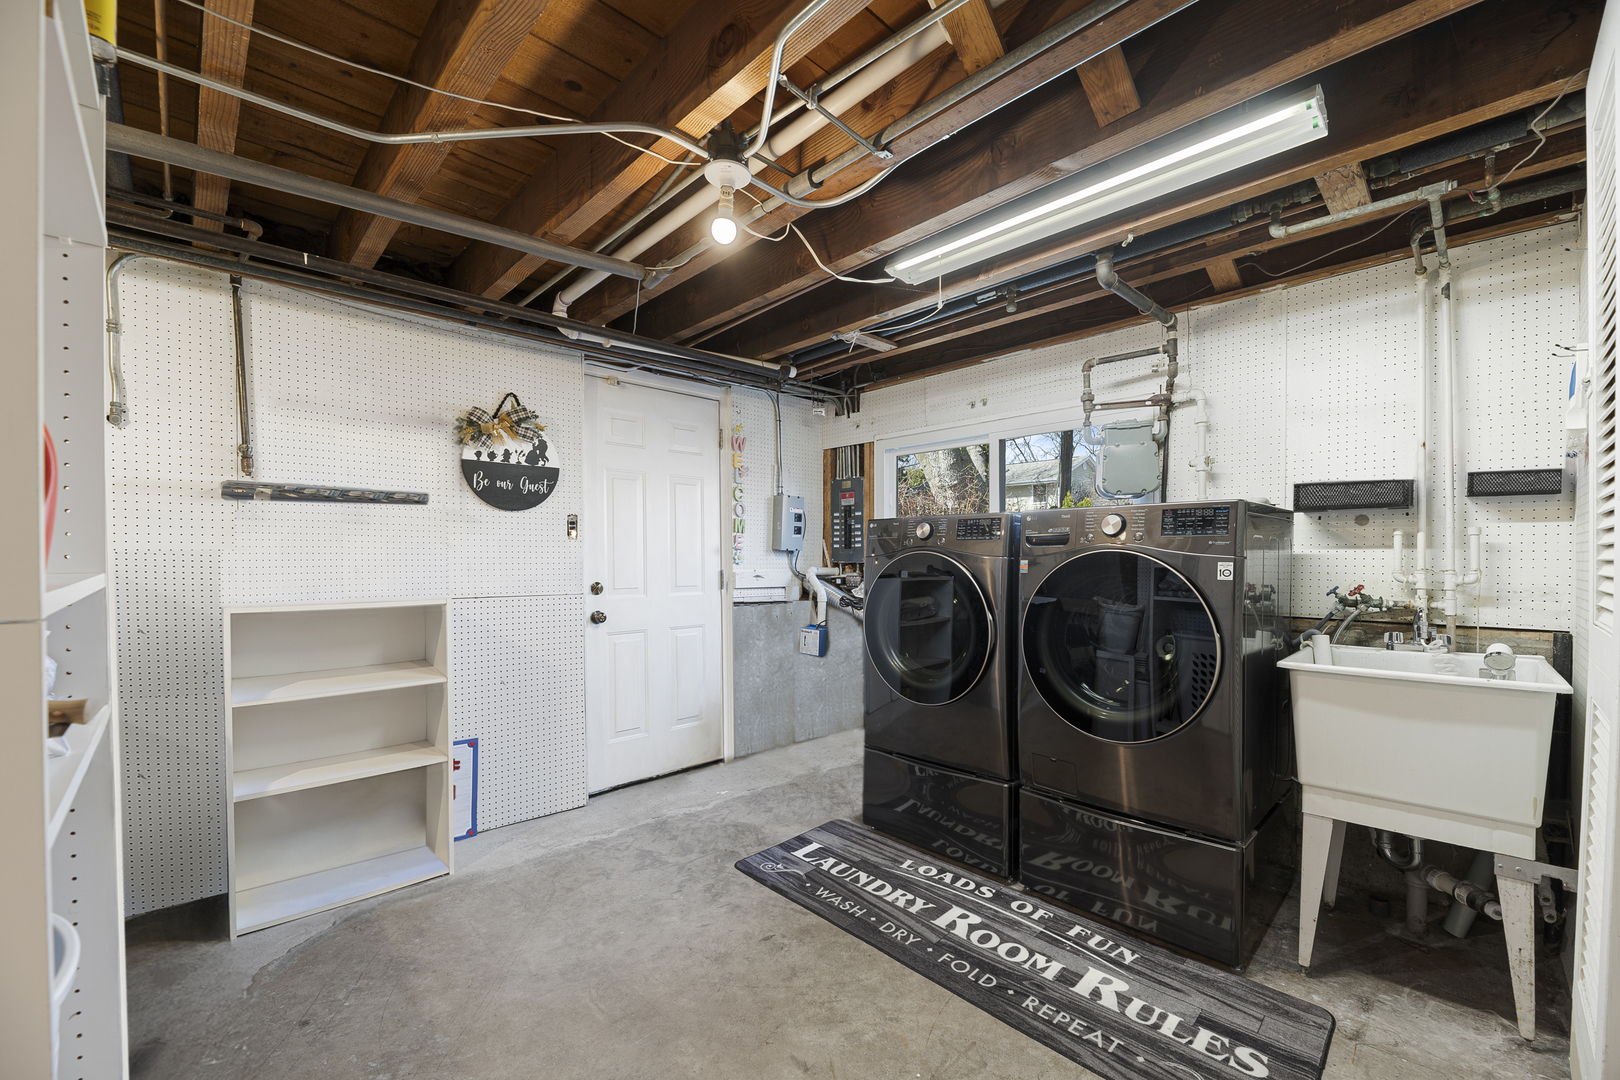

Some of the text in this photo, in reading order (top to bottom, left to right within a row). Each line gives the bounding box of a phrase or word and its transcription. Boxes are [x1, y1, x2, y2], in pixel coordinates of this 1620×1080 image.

[473, 470, 555, 495] Be our Guest
[1219, 568, 1232, 578] 10
[791, 841, 1270, 1078] LAUNDRY ROOM RULES
[899, 859, 1140, 966] LOADS OF FUN
[815, 886, 1125, 1053] WASH DRY FOLD REPEAT
